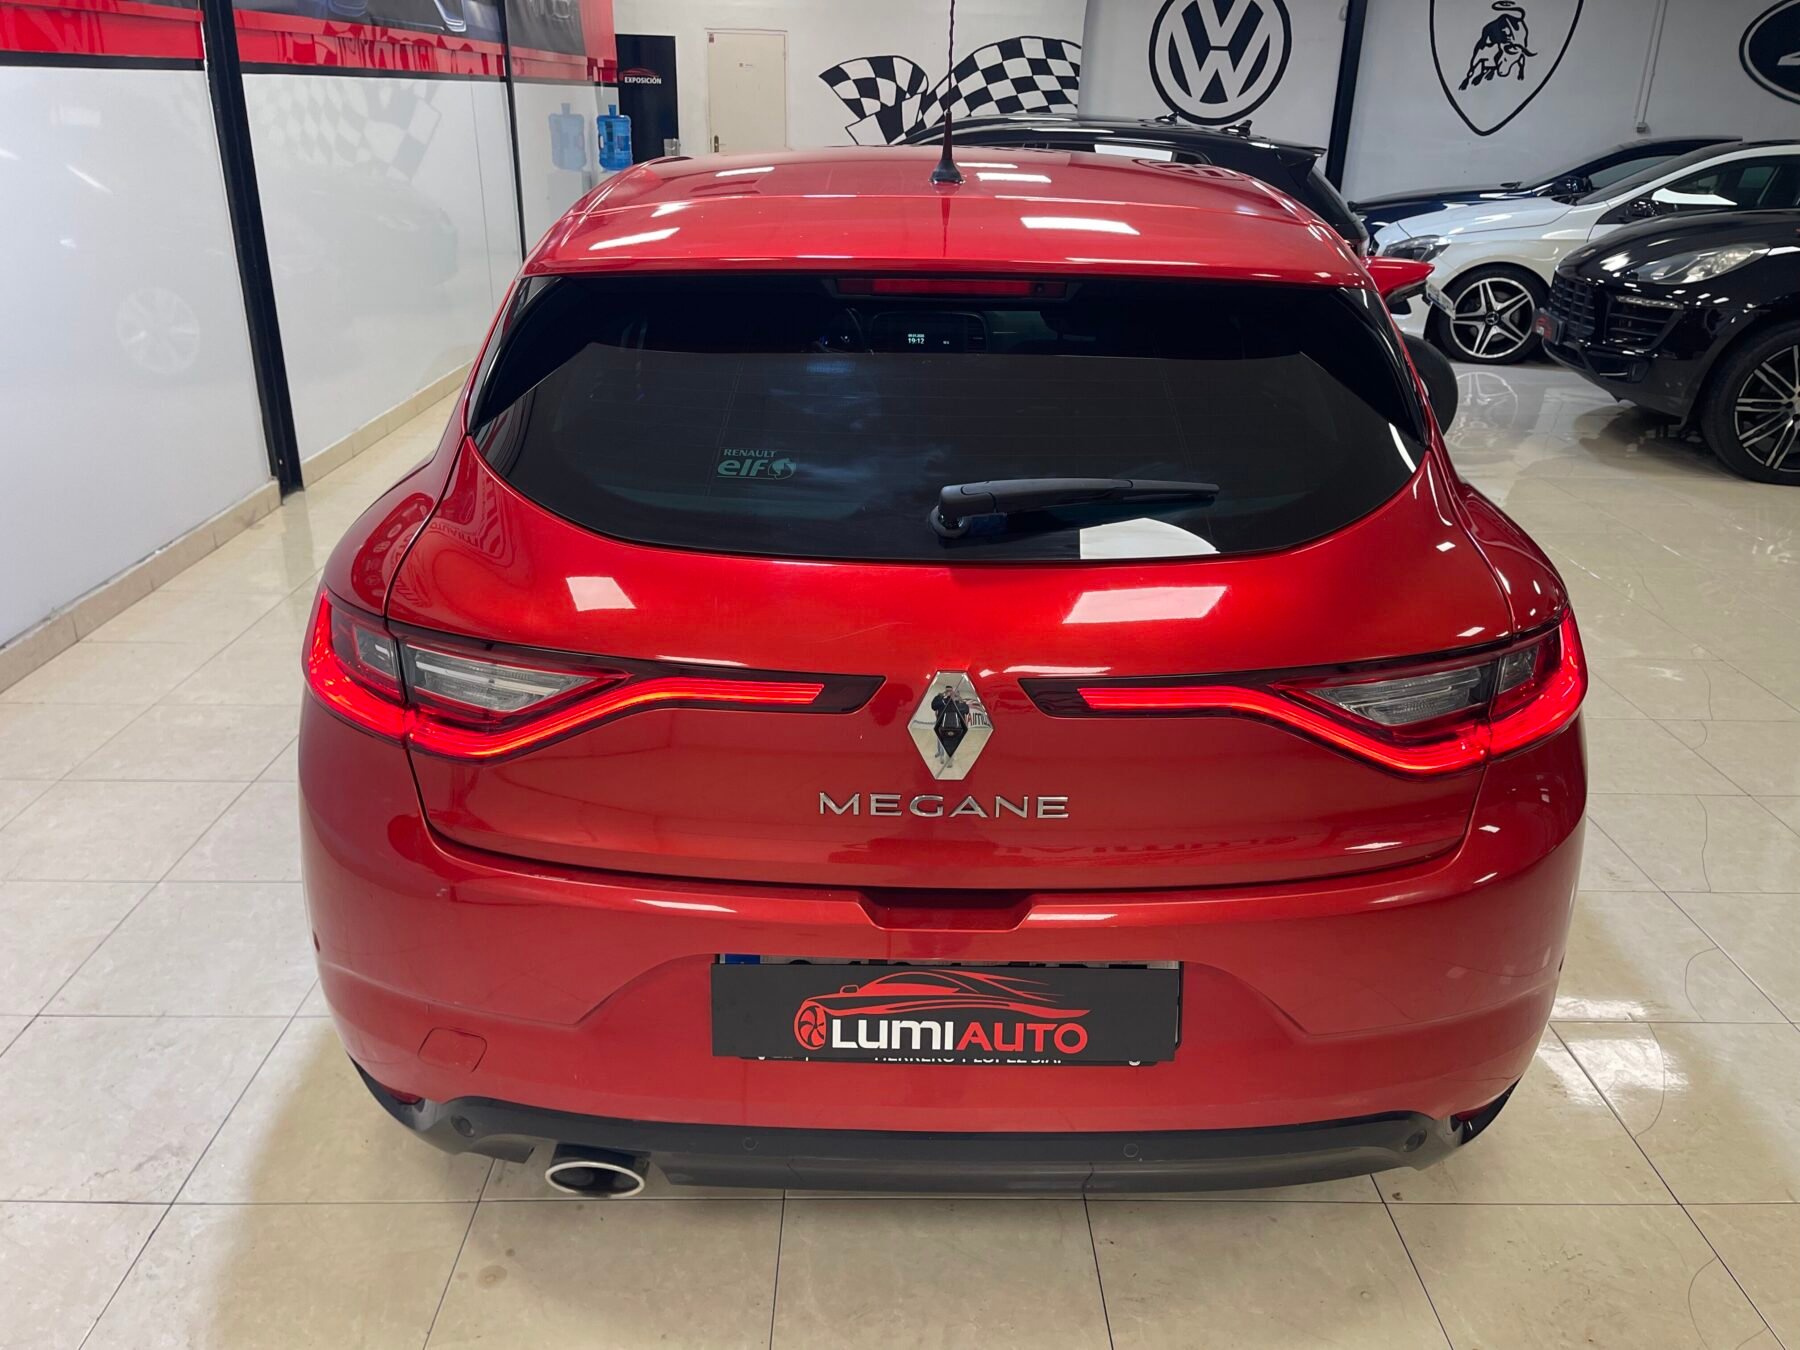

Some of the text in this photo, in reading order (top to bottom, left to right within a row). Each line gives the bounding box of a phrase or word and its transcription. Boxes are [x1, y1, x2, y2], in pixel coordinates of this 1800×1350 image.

[624, 76, 662, 85] EXPOSICIÓN
[907, 337, 925, 345] 19:12
[723, 448, 777, 458] RENAULT
[717, 459, 769, 477] elf
[818, 791, 1070, 820] MEGANE
